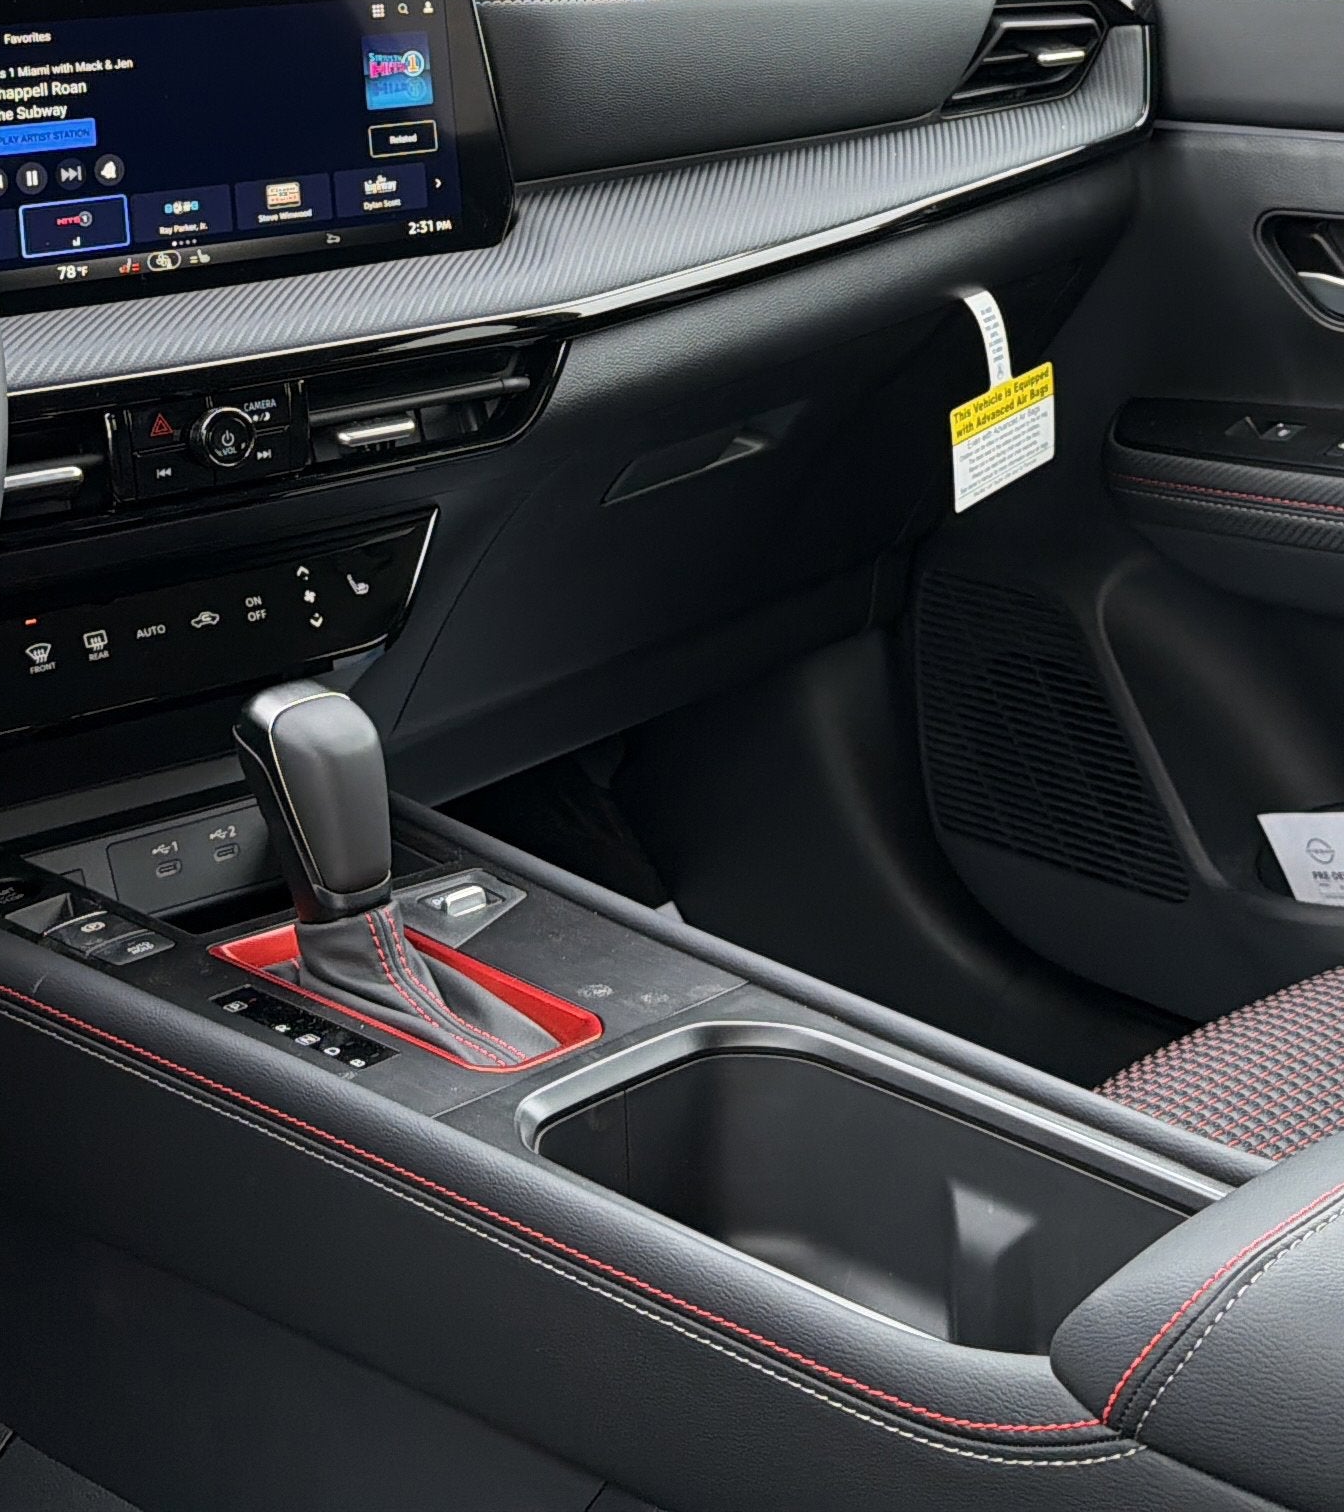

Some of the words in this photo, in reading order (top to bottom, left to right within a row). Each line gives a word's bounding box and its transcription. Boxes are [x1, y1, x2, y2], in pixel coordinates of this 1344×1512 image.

[3, 31, 52, 46] Favorites
[8, 66, 15, 79] 1
[17, 63, 50, 78] Miami
[51, 61, 74, 75] with
[75, 59, 104, 74] Mack
[104, 58, 113, 71] &
[114, 57, 134, 70] Jen
[51, 80, 88, 96] Roan
[16, 102, 68, 120] Subway
[20, 131, 51, 144] ARTIST
[52, 127, 91, 141] STATION
[408, 219, 435, 236] 2:31
[435, 219, 453, 232] PM
[954, 407, 972, 424] This
[973, 392, 1004, 412] Vehicle
[1013, 366, 1050, 393] Equipped
[243, 398, 277, 412] CAMERA
[956, 422, 975, 439] with
[975, 401, 1015, 429] Advanced
[1029, 384, 1049, 402] Bags
[222, 446, 238, 456] VOL
[245, 595, 263, 608] ON
[247, 607, 268, 622] OFF
[135, 624, 167, 640] AUTO
[88, 649, 110, 661] REAR
[29, 660, 57, 675] FRONT
[227, 825, 237, 838] 2
[171, 841, 179, 852] 1
